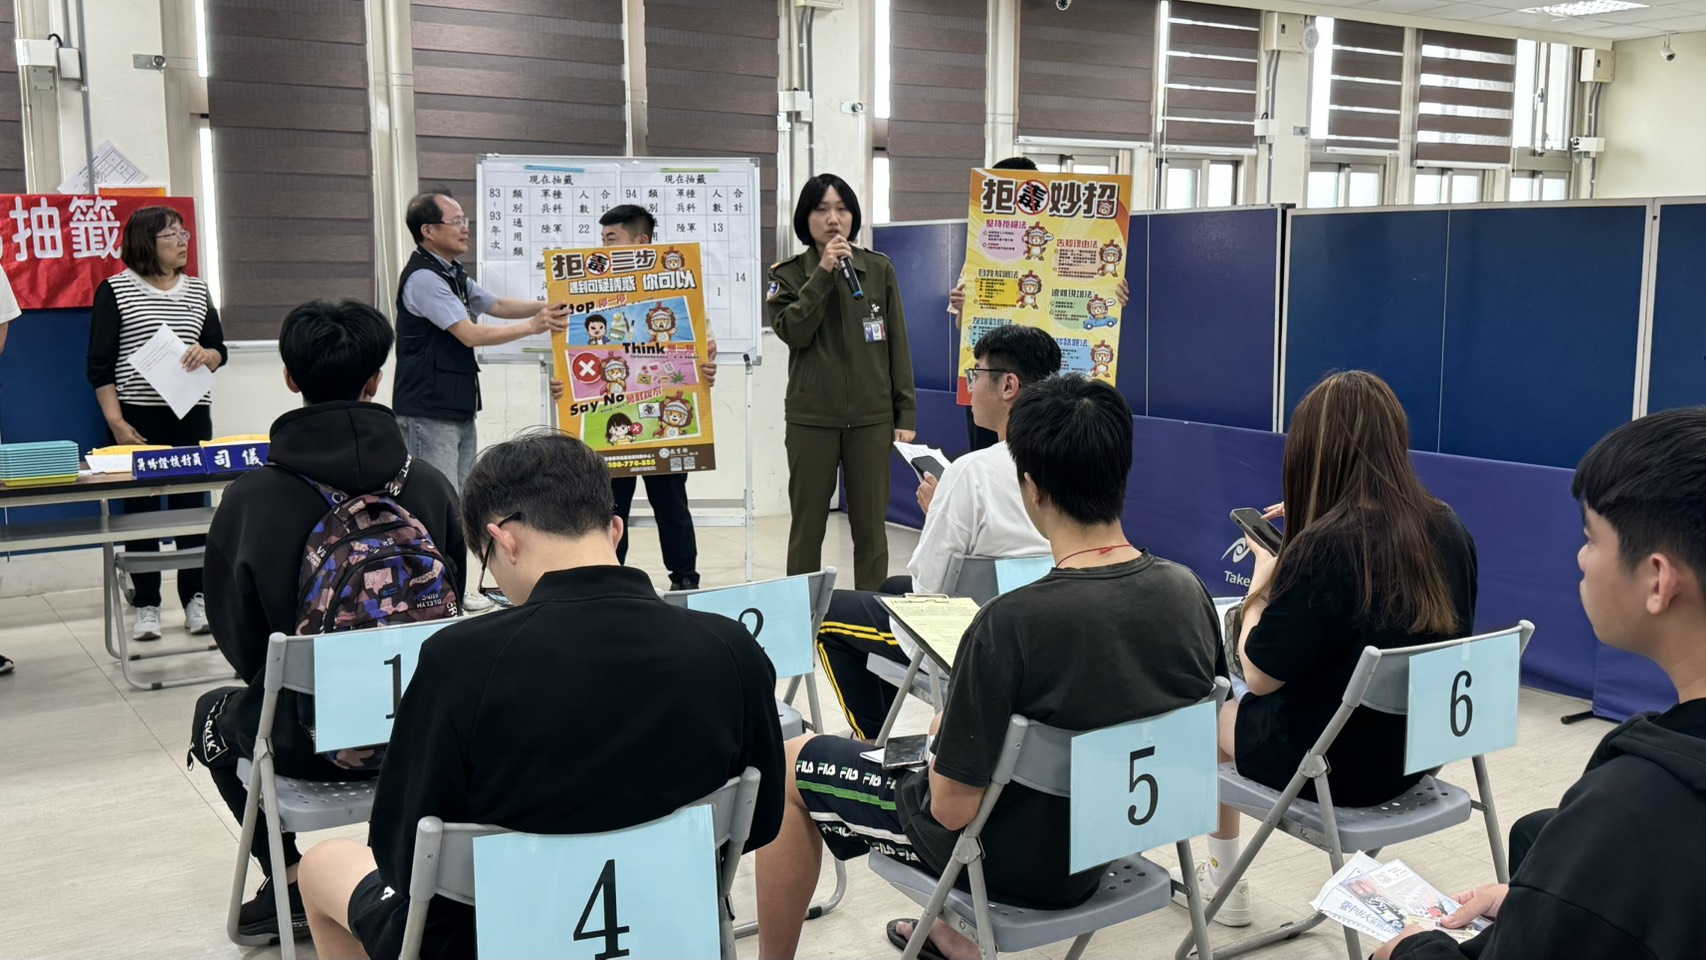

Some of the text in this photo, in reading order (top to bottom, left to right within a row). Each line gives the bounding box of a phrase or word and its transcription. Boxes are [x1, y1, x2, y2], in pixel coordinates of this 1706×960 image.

[529, 175, 573, 185] 現在抽籤
[664, 174, 706, 185] 現在抽籤
[541, 189, 562, 199] 軍種
[625, 189, 636, 198] 94
[676, 189, 695, 199] 軍種
[982, 178, 1119, 218] 拒毒妙招
[0, 196, 121, 262] 抽籤
[541, 224, 562, 234] 陸軍
[578, 224, 589, 233] 22
[676, 223, 696, 232] 陸軍
[713, 223, 723, 232] 13
[1057, 239, 1097, 248] 告知理由法
[552, 249, 657, 280] 拒毒三步
[643, 270, 696, 291] 你可以
[735, 273, 746, 282] 14
[717, 287, 721, 296] 1
[622, 342, 665, 354] Think
[570, 400, 598, 416] Say
[604, 393, 624, 406] No
[214, 447, 264, 468] 司儀
[1224, 570, 1251, 587] Take
[384, 653, 402, 719] 1
[1449, 670, 1473, 737] 6
[817, 762, 836, 776] FILA
[839, 766, 859, 781] FILA
[862, 772, 882, 787] FILA
[1127, 745, 1159, 826] 5
[573, 859, 630, 960] 4
